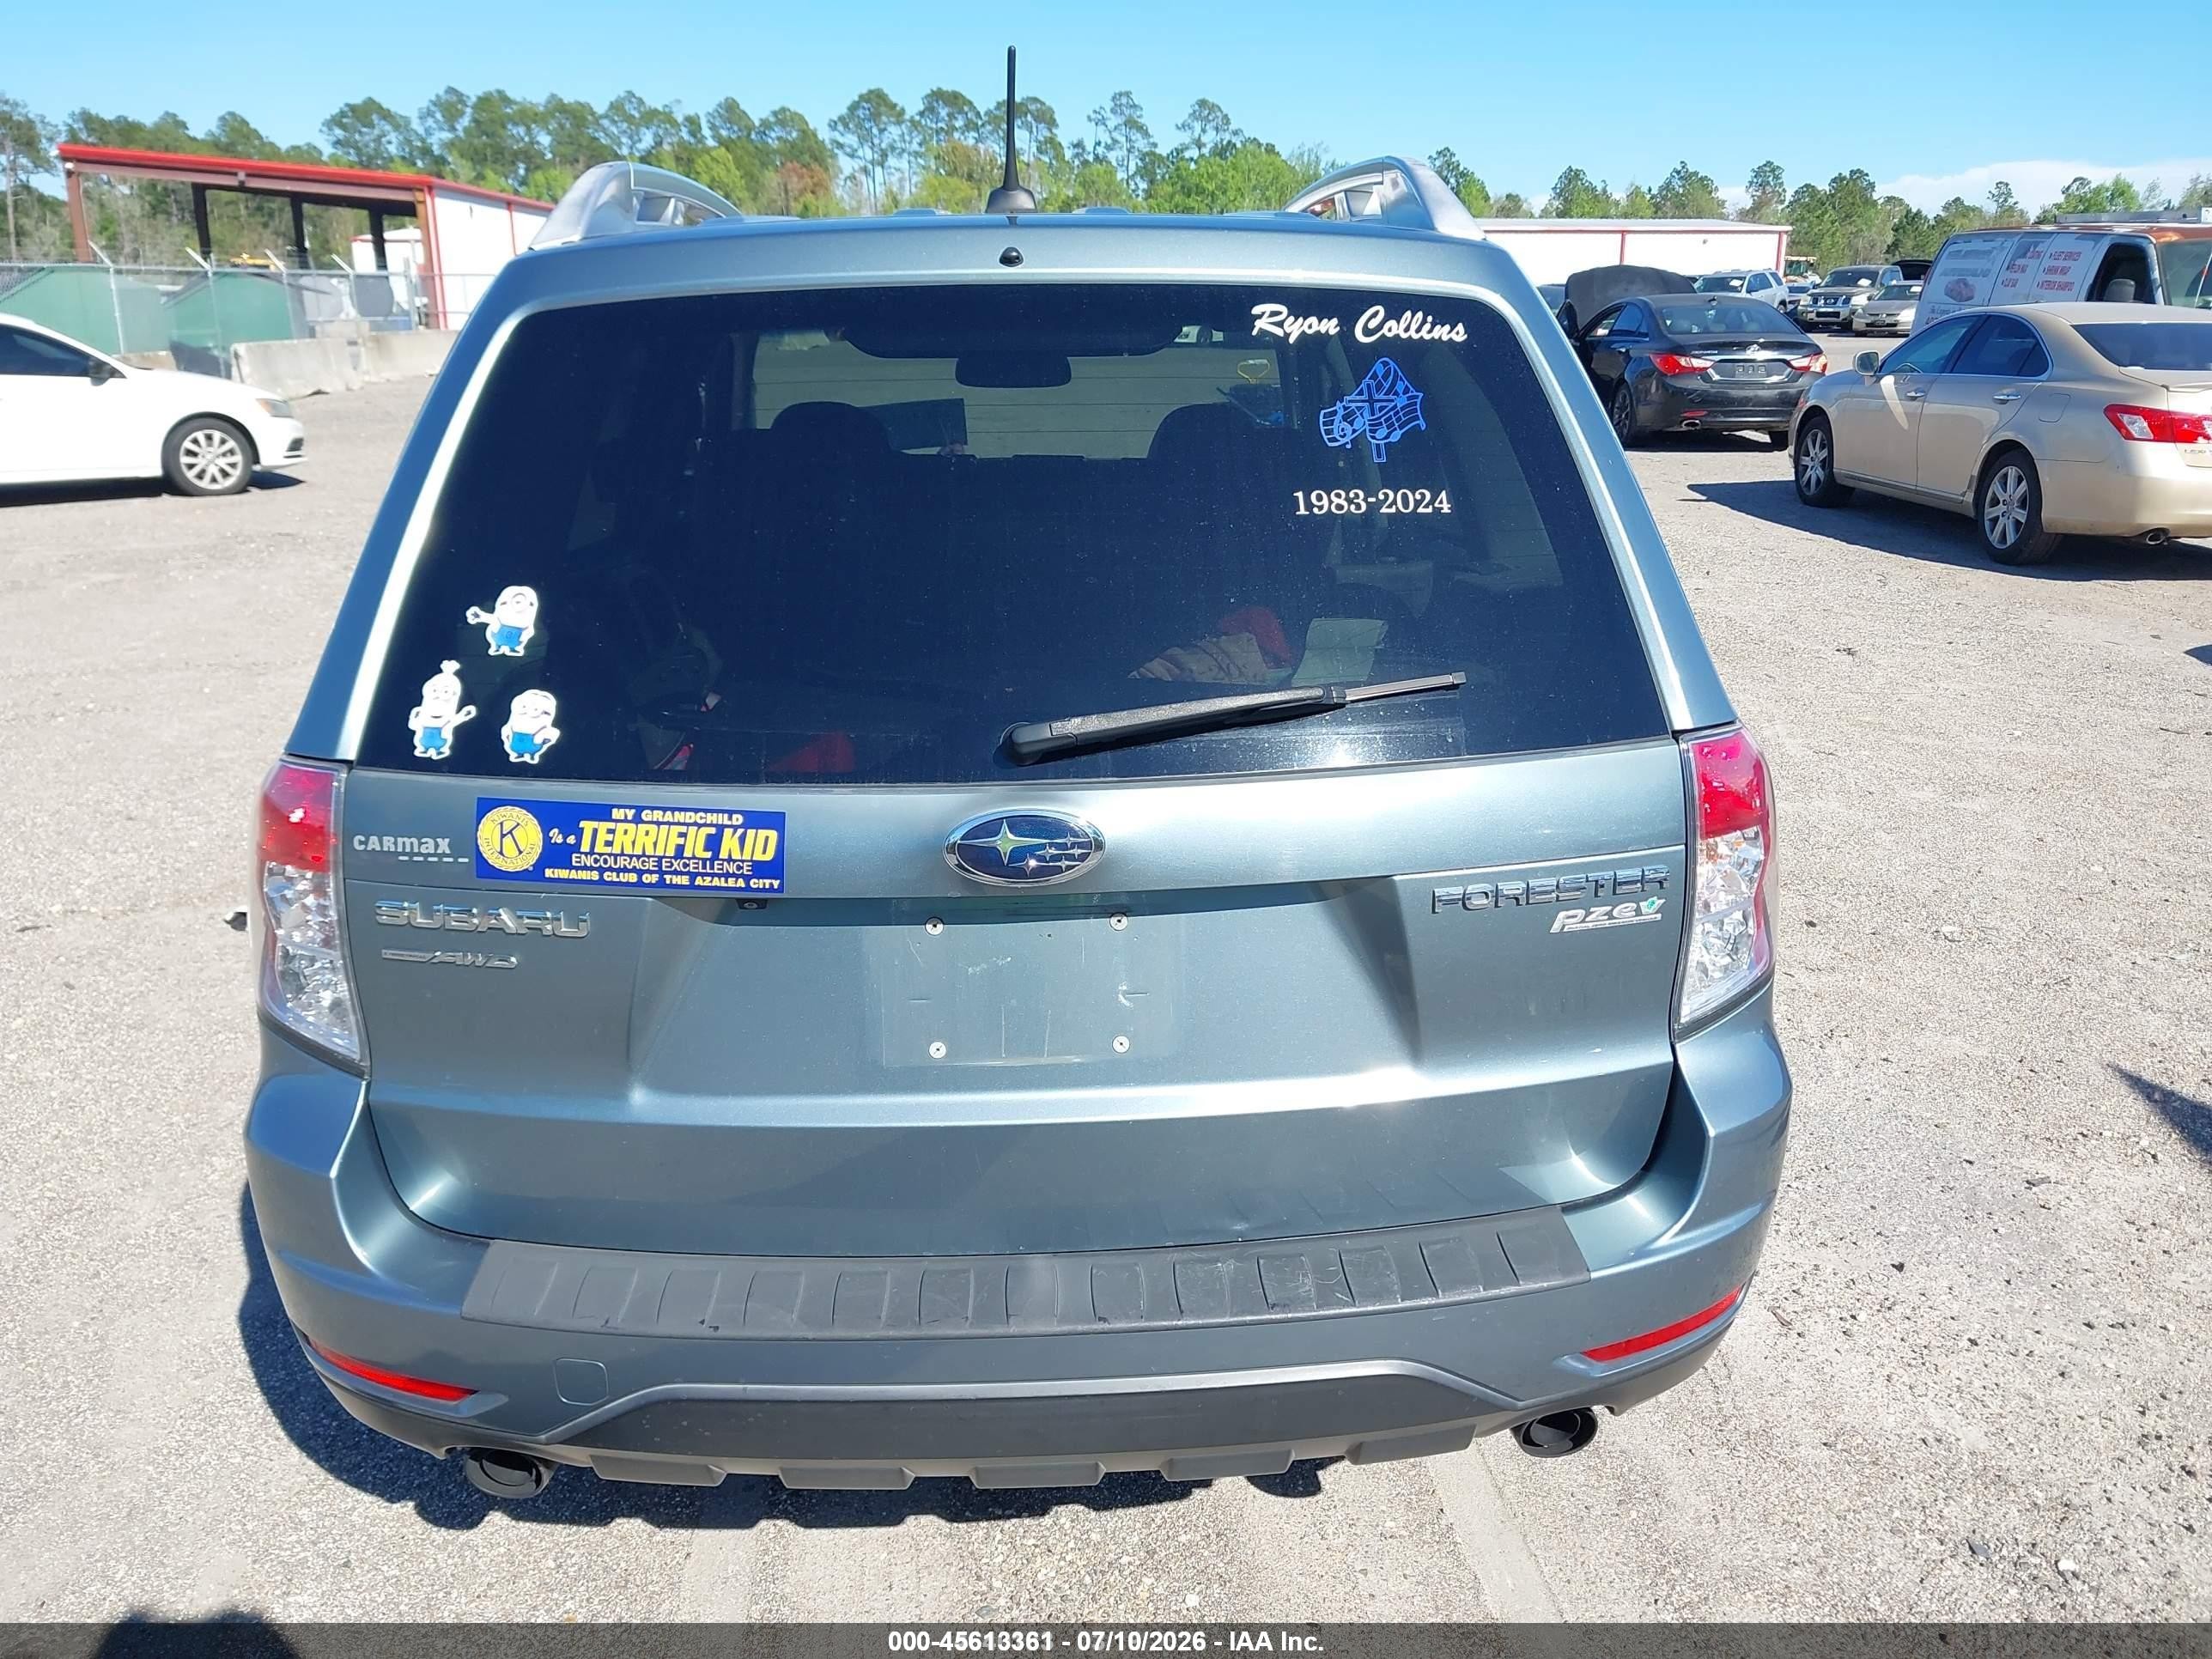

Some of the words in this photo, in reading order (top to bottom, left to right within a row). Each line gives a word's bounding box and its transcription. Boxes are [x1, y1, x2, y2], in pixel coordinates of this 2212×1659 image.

[1251, 303, 1340, 343] Ryon
[1354, 305, 1468, 343] Collins
[1293, 489, 1451, 515] 1983-2024
[490, 811, 529, 828] KIWANIS
[611, 808, 635, 820] MY
[641, 810, 744, 825] GRANDCHILD
[549, 828, 563, 844] Is
[566, 835, 576, 844] a
[579, 820, 716, 859] TERRIFIC
[719, 828, 778, 861] KID
[571, 854, 659, 871] ENCOURAGE
[661, 859, 753, 875] EXCELLENCE
[544, 868, 599, 880] KIWANIS
[603, 872, 638, 883] CLUB
[641, 873, 659, 884] OF
[663, 874, 690, 885] THE
[694, 876, 746, 888] AZALEA
[749, 878, 781, 890] CITY
[1431, 865, 1670, 914] FORESTER
[374, 900, 591, 939] SUBARU
[431, 950, 519, 969] AWD
